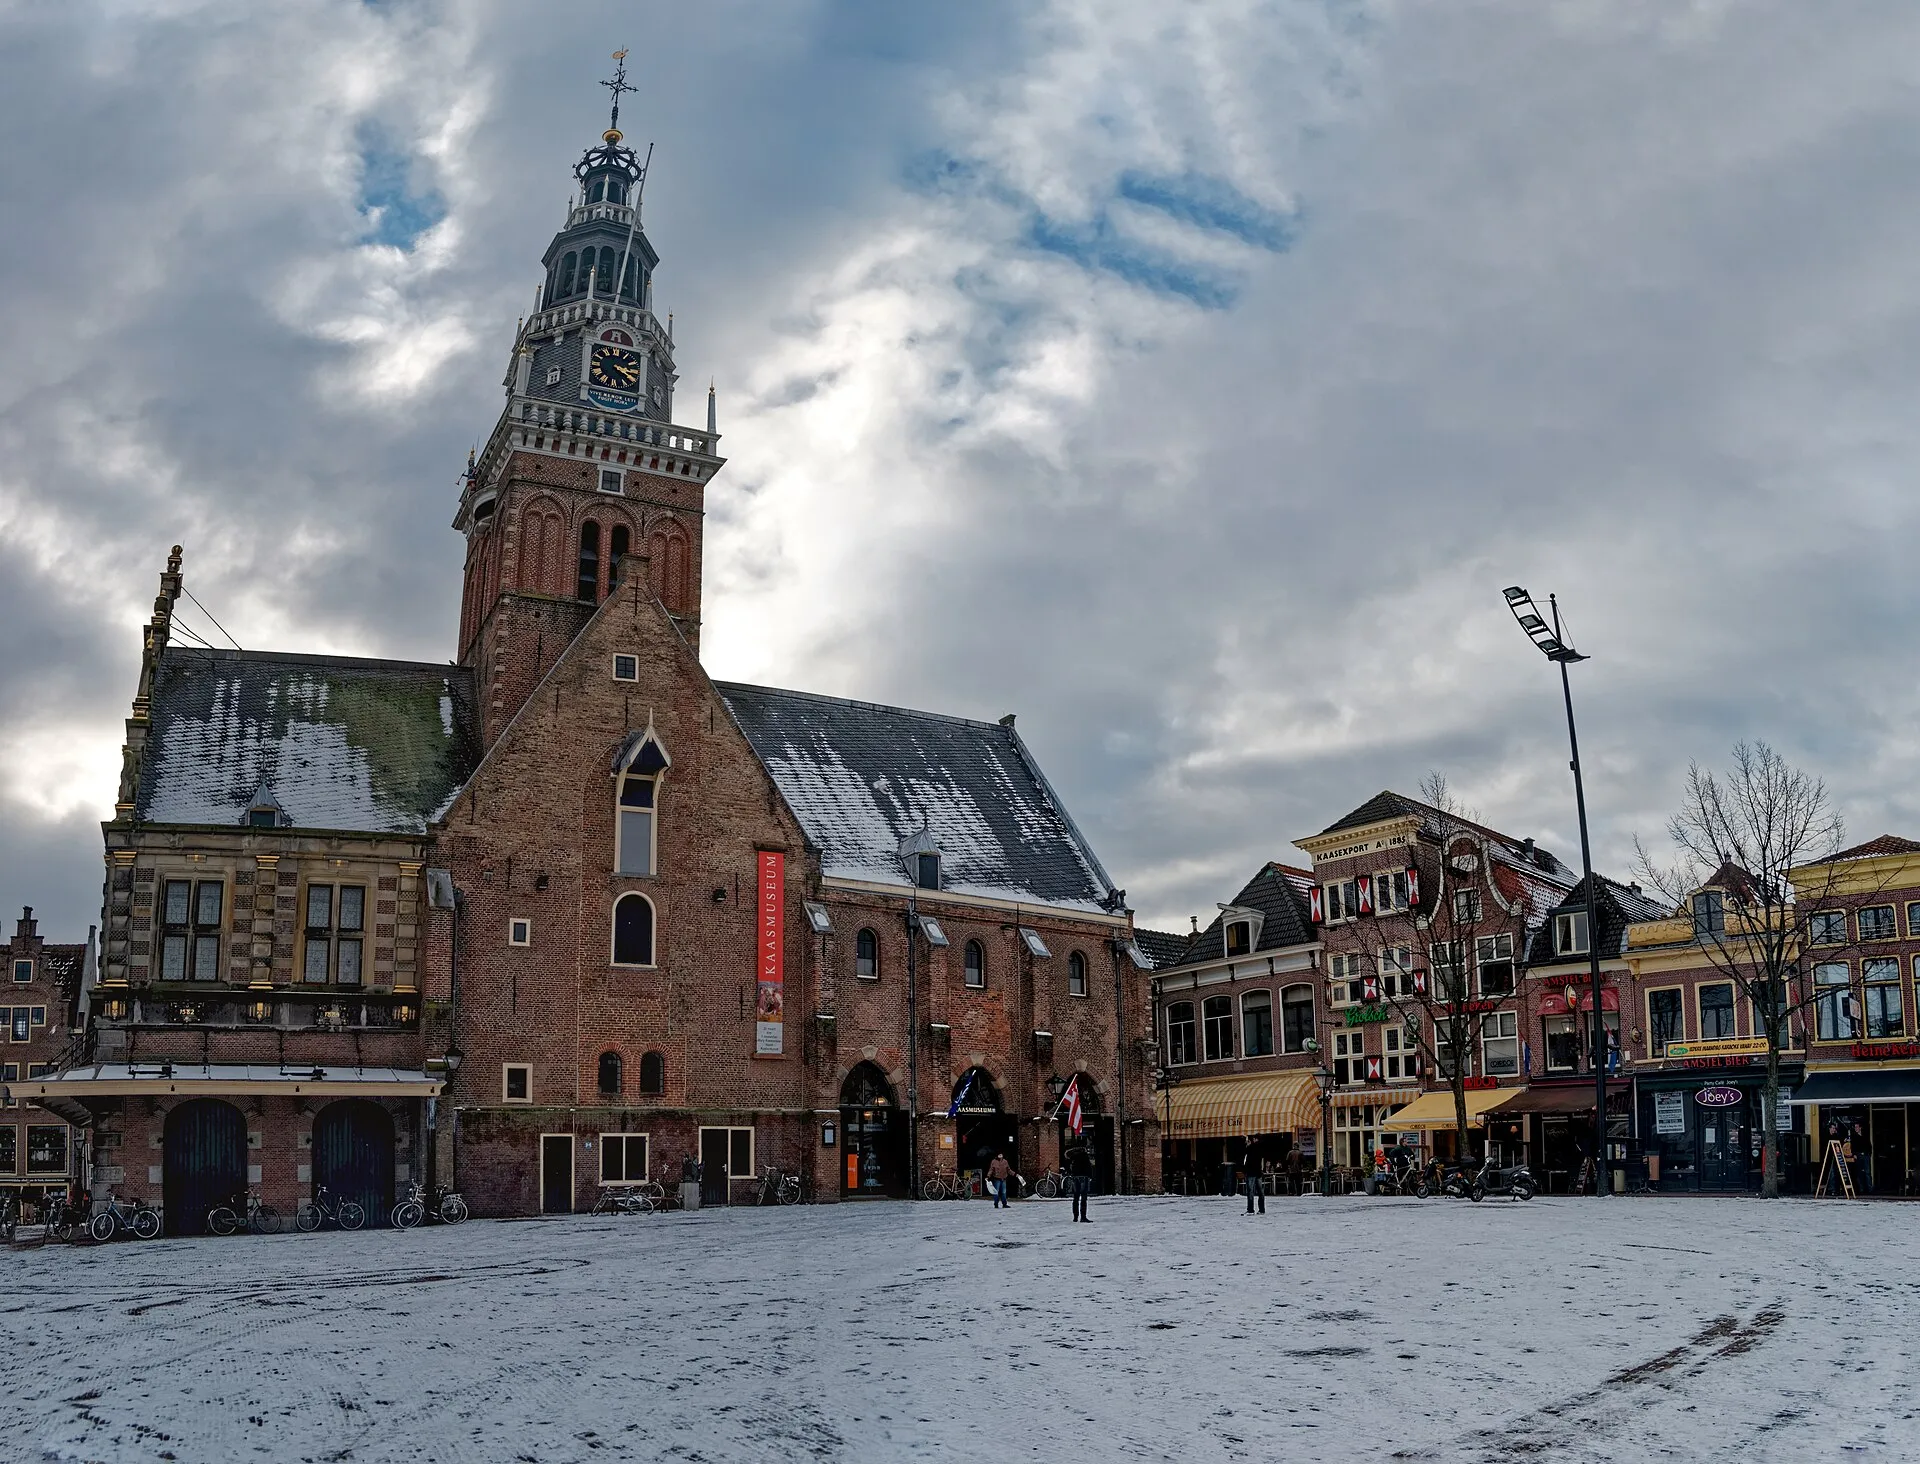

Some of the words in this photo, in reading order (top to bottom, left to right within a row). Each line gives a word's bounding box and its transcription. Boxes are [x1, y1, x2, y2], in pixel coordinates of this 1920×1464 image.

[1316, 844, 1369, 861] KAASEXPORT
[1389, 836, 1406, 845] 1885
[765, 856, 776, 974] KAASMUSEUM
[1543, 975, 1580, 986] AMSTEL
[1583, 973, 1606, 983] BIR
[1344, 1002, 1387, 1028] Grolsch
[1851, 1043, 1917, 1057] Heineken
[1683, 1057, 1722, 1068] AMSTEL
[1725, 1056, 1750, 1066] BIER
[1702, 1090, 1735, 1104] Joey's
